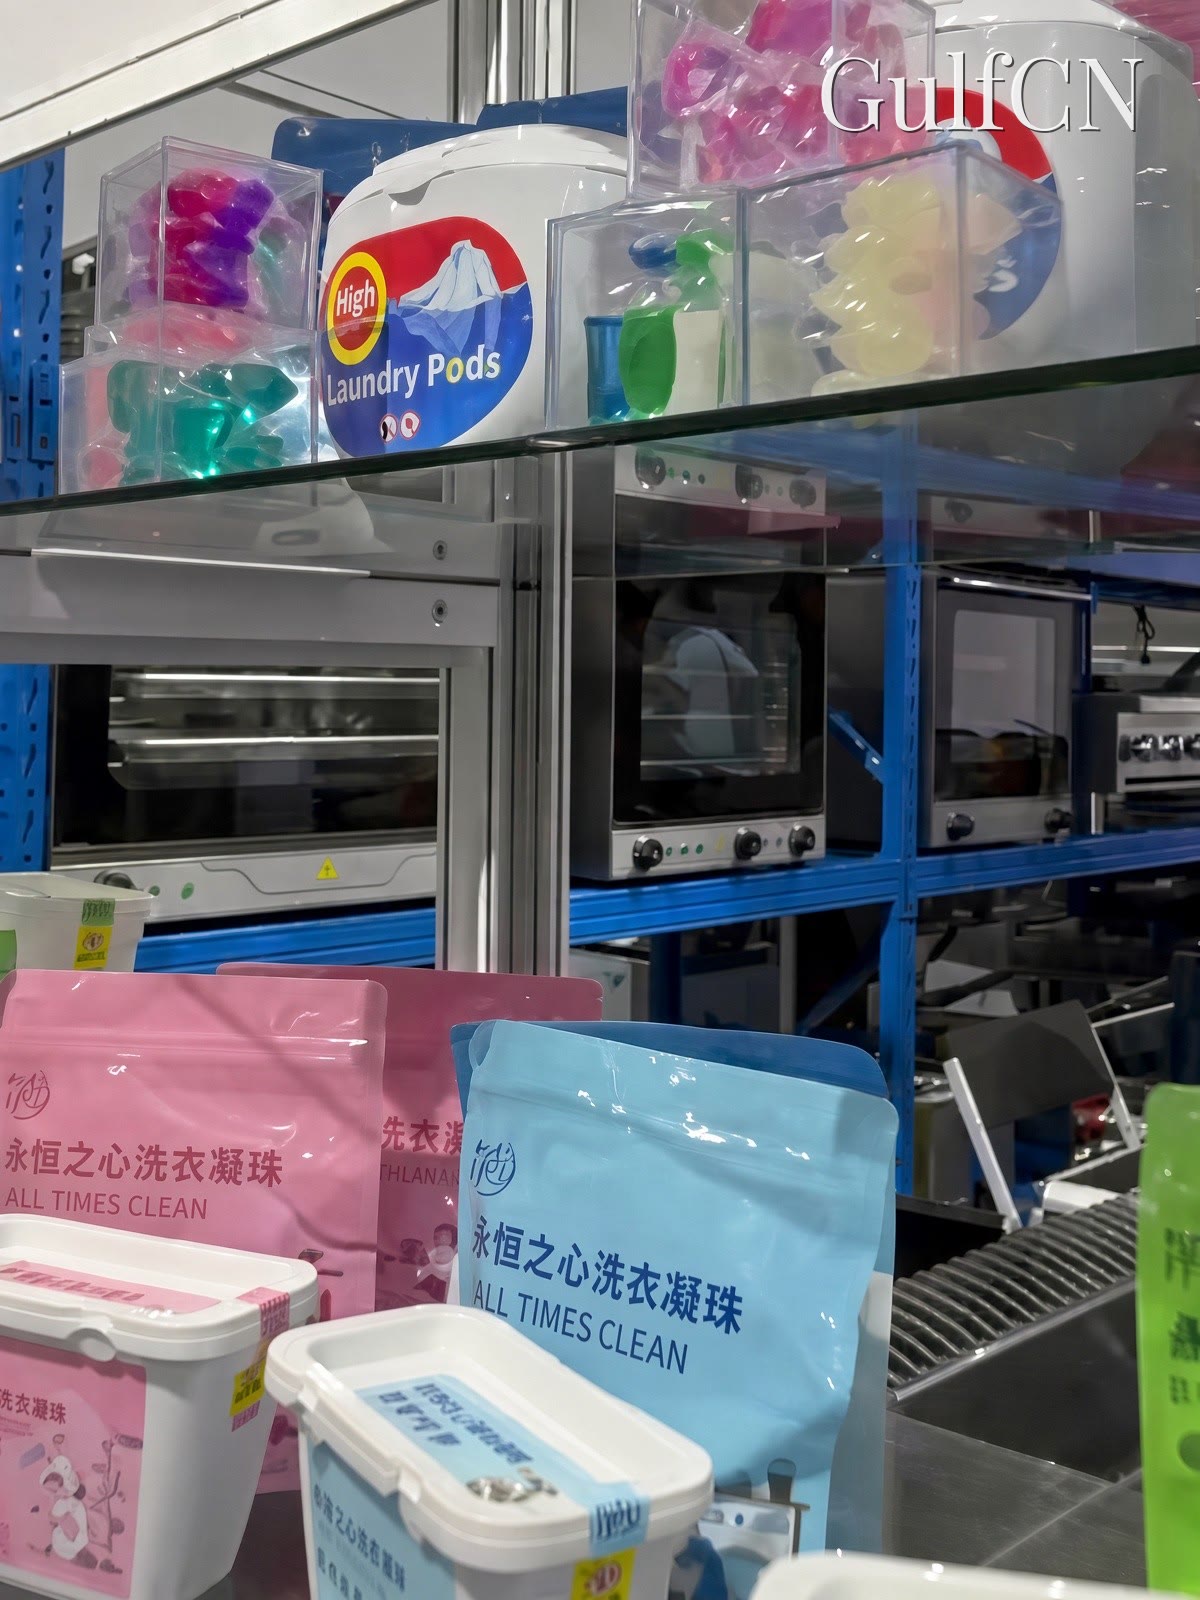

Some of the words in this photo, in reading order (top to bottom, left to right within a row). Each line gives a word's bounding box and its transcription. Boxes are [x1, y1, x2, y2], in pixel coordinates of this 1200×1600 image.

[336, 278, 376, 318] High
[327, 359, 421, 407] Laundry
[427, 343, 501, 387] Pods
[5, 1136, 283, 1188] 永恒之心洗衣凝珠
[5, 1186, 45, 1210] ALL
[51, 1189, 121, 1216] TIMES
[128, 1194, 208, 1220] CLEAN
[472, 1214, 744, 1335] 永恒之心洗衣凝珠
[473, 1279, 509, 1319] ALL
[517, 1291, 593, 1343] TIMES
[599, 1318, 689, 1375] CLEAN
[0, 1388, 67, 1425] 洗衣凝珠
